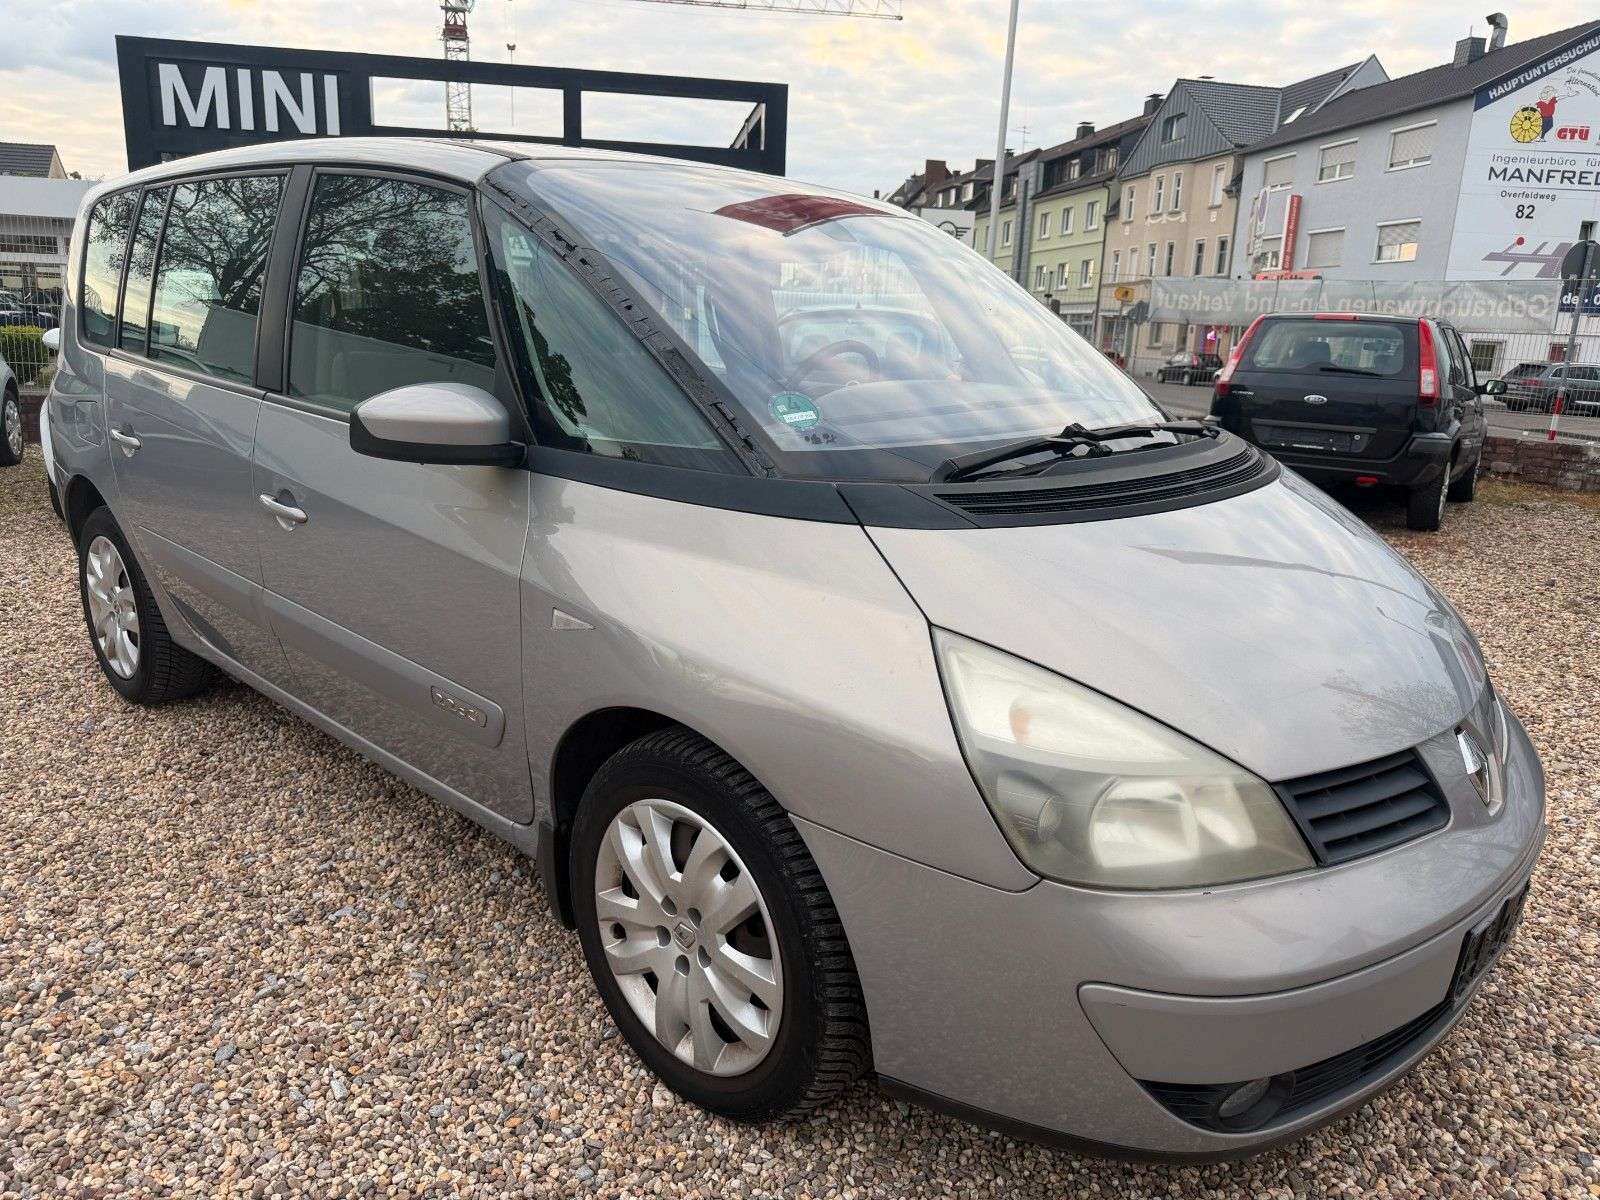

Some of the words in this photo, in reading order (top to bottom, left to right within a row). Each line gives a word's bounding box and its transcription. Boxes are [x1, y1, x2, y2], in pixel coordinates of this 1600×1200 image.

[1488, 35, 1600, 99] HAUPTUNTERSUCHU
[158, 63, 341, 136] MINI
[1556, 125, 1590, 141] GTÜ
[1491, 154, 1577, 167] Ingenieurbüro
[1500, 190, 1557, 202] Overfeldweg
[1515, 204, 1535, 219] 82
